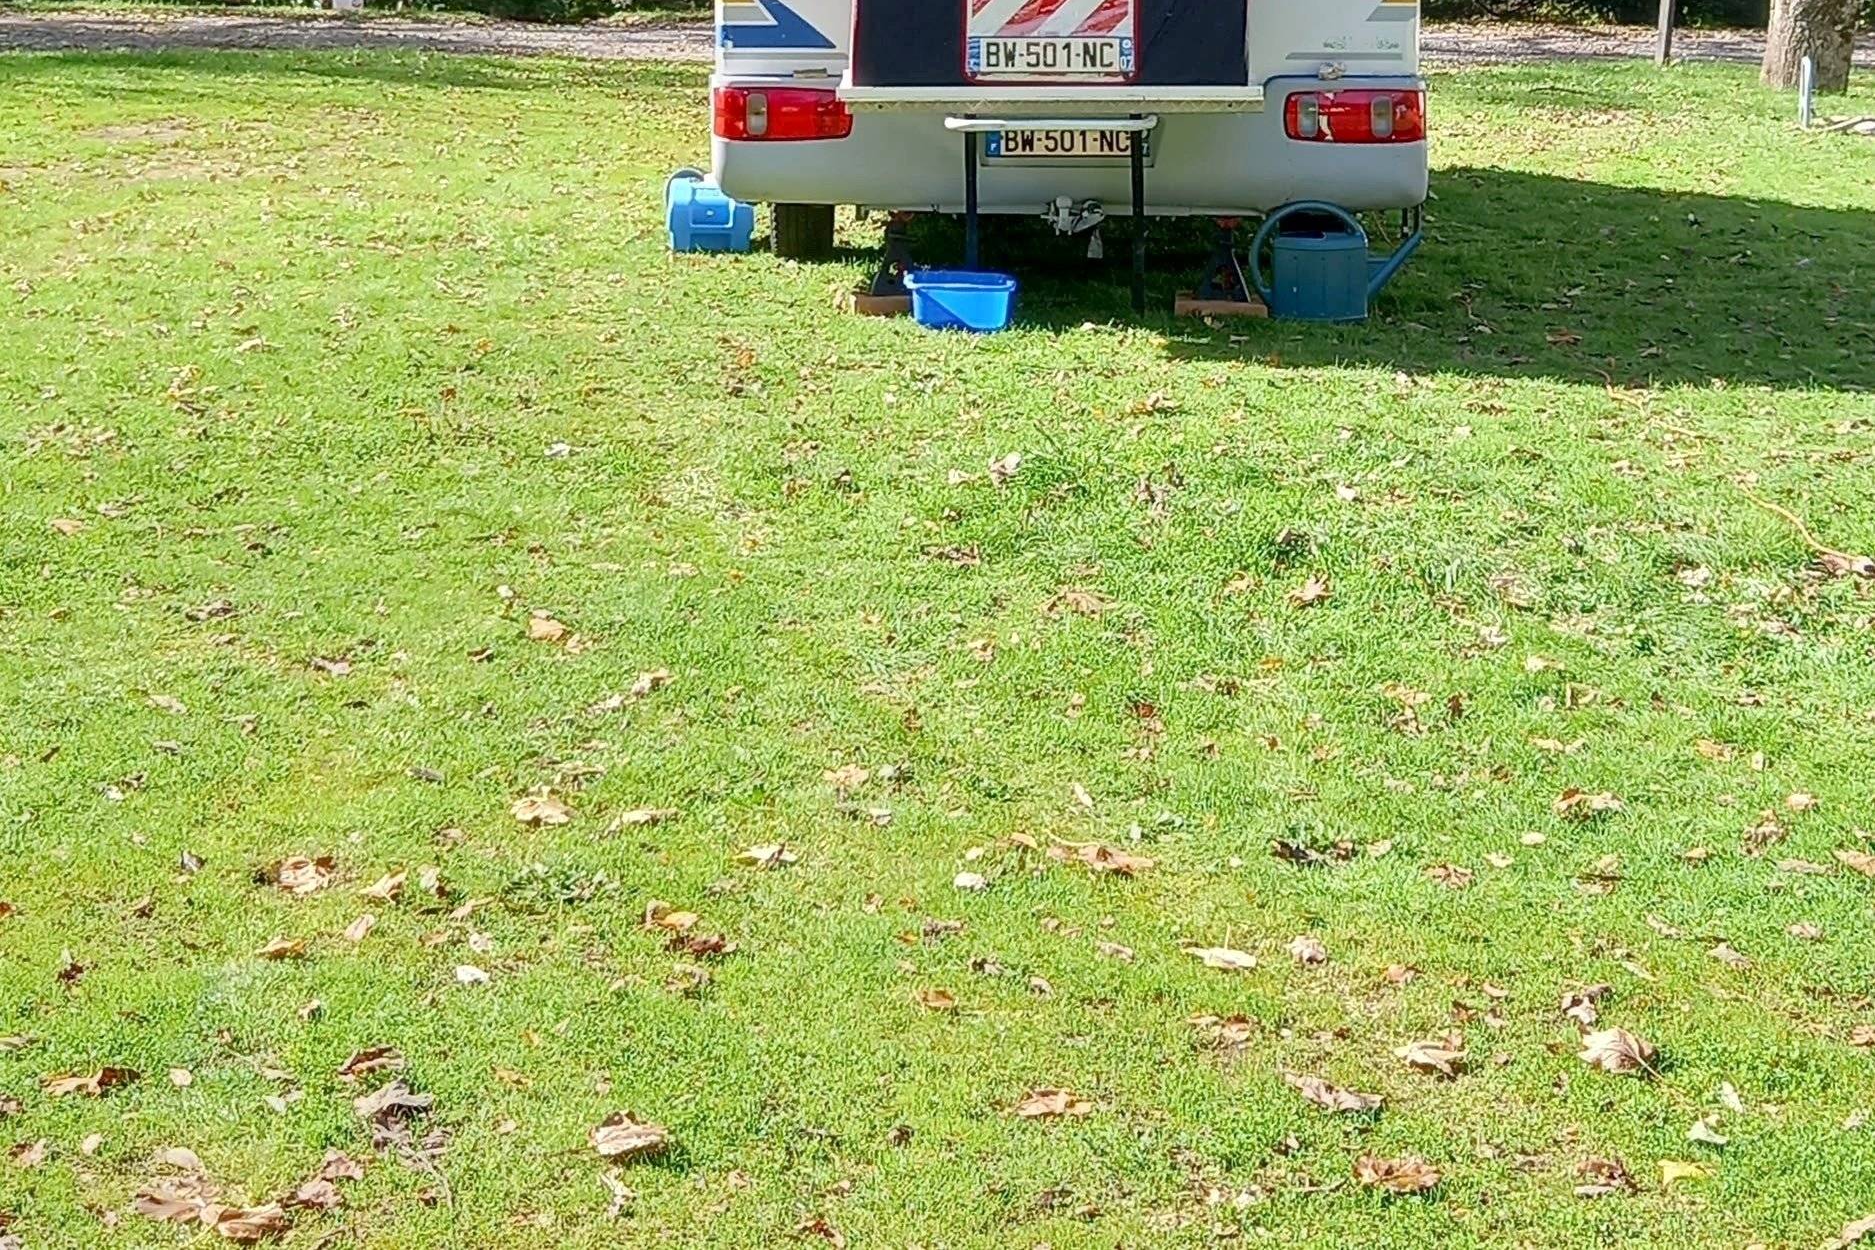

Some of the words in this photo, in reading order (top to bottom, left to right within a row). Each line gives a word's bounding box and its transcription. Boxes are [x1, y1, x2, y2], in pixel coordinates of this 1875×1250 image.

[985, 41, 1114, 68] BW-501-NC
[1119, 55, 1133, 71] 07
[1004, 130, 1131, 153] BW-501-NC
